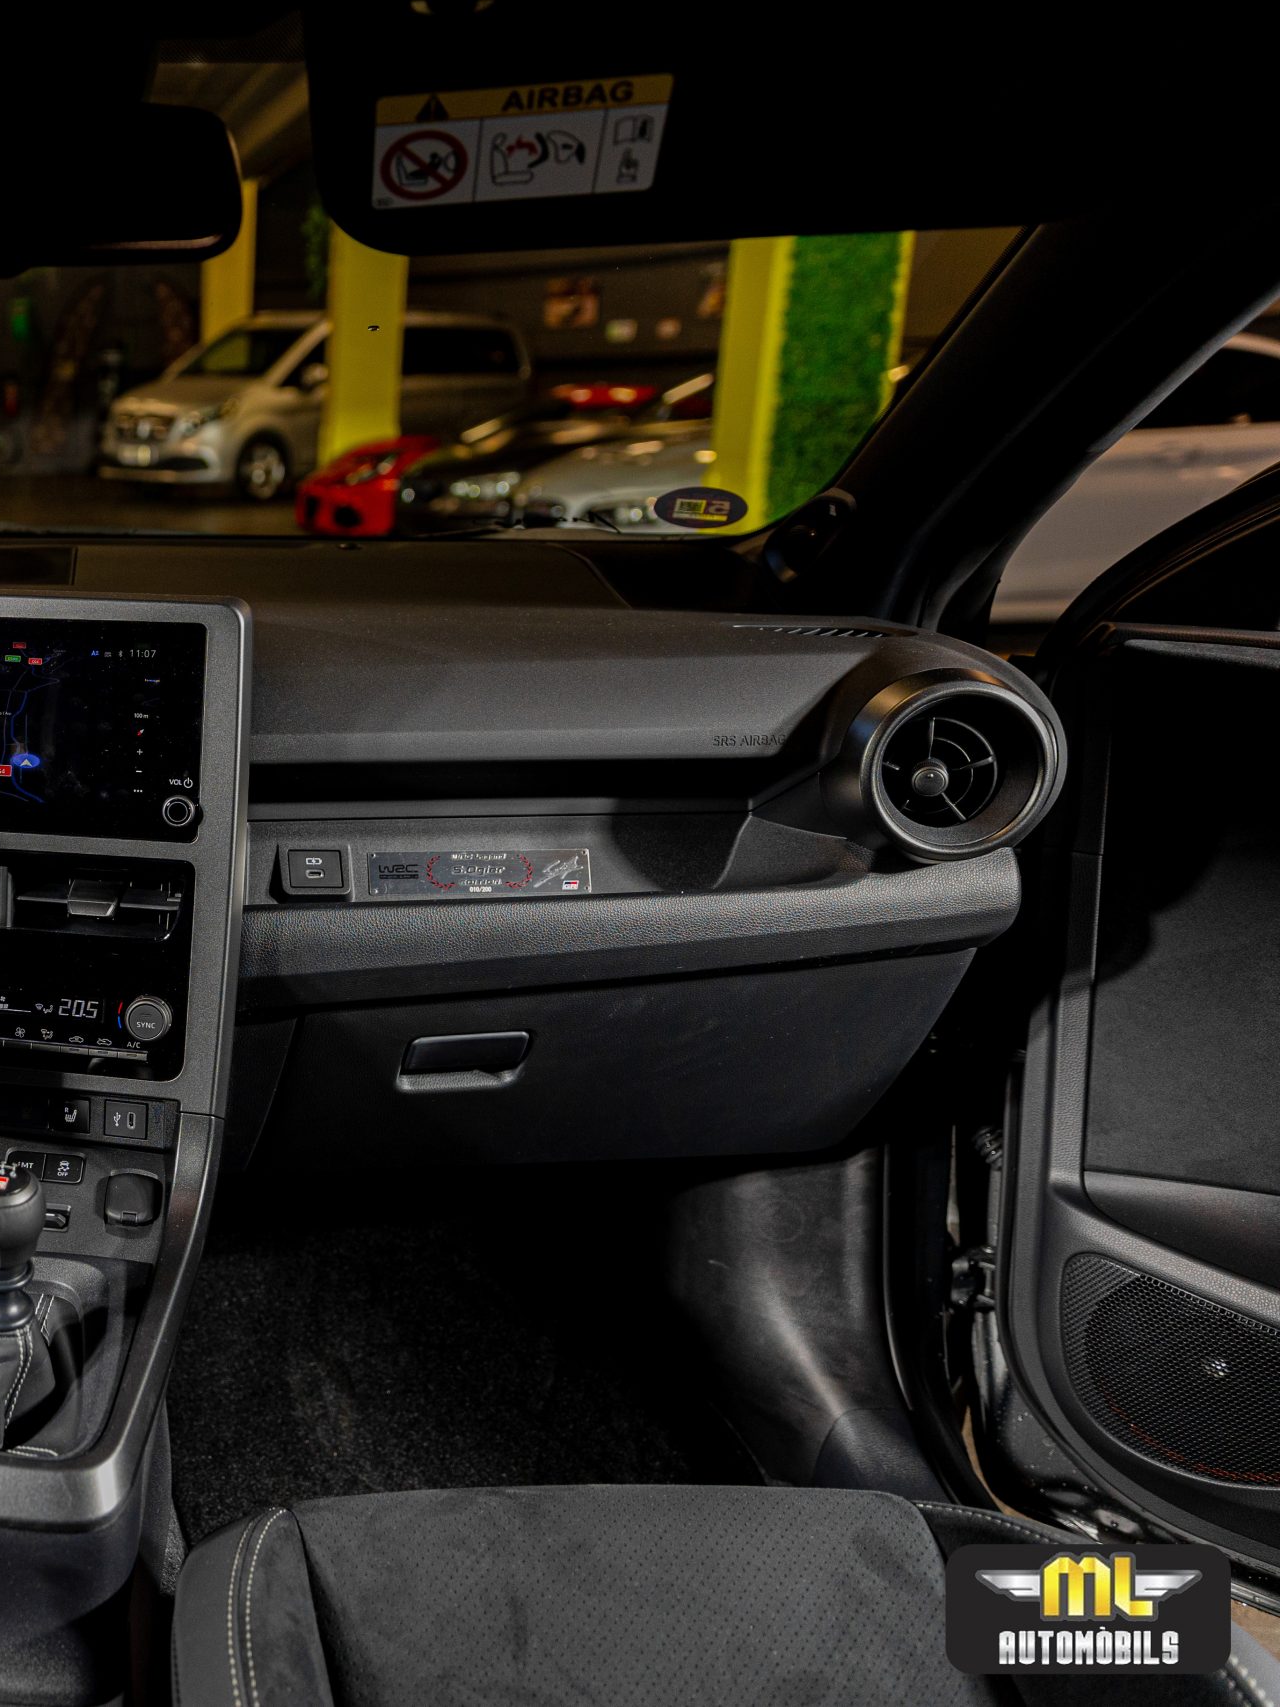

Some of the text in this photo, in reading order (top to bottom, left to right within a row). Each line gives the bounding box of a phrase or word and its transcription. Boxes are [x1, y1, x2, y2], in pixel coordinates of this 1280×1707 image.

[502, 80, 634, 112] AIRBAG
[130, 649, 157, 658] 11:07
[713, 735, 736, 746] SRS
[168, 778, 183, 786] VOL
[378, 864, 419, 873] WRC
[136, 1021, 156, 1029] SYNC
[126, 1041, 141, 1049] A/C
